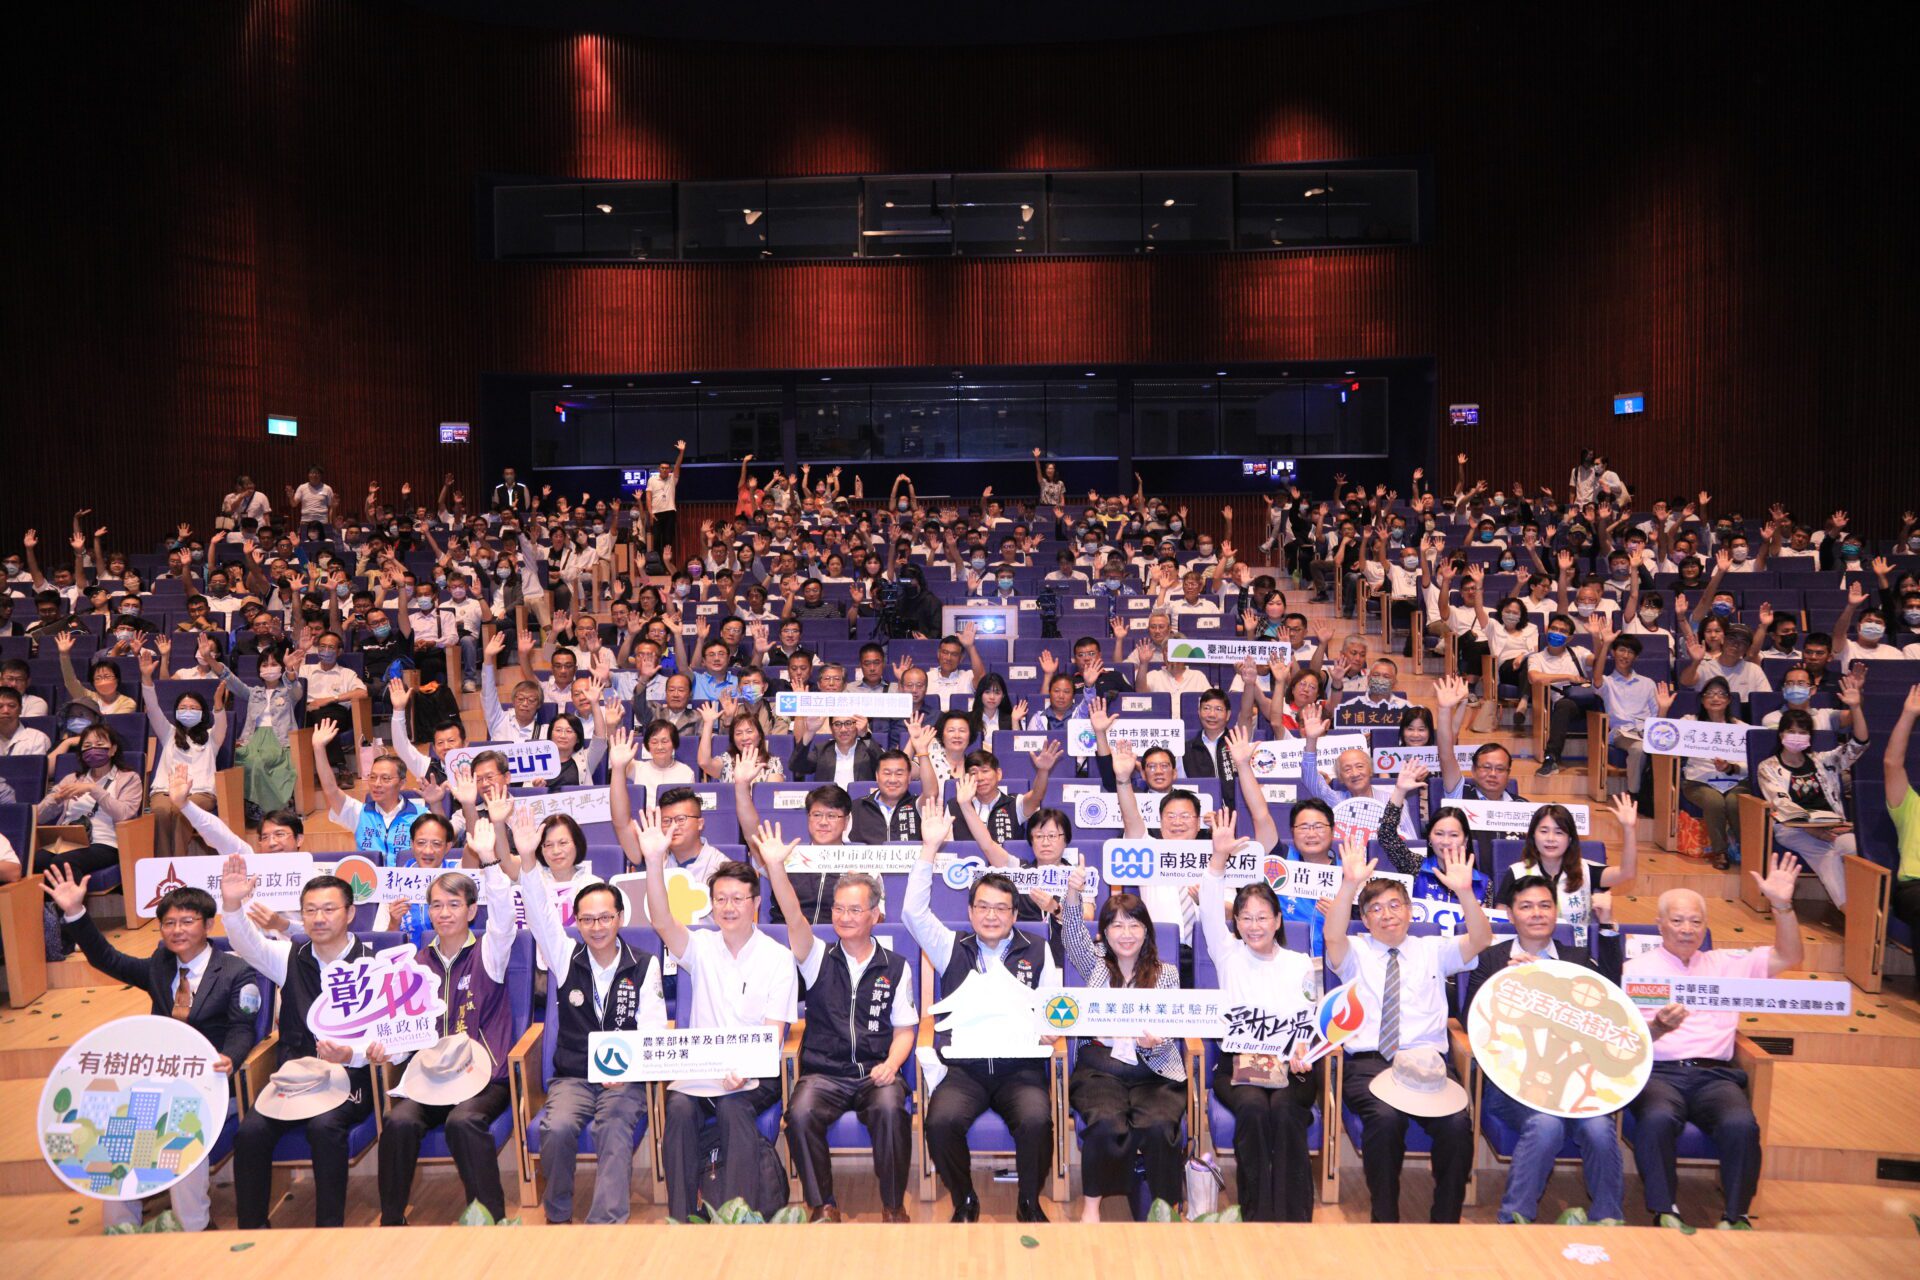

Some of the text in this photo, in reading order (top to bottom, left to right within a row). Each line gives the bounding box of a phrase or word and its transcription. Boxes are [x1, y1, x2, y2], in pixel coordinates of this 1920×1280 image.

[1109, 728, 1180, 738] 台中市景觀工程
[1109, 739, 1170, 748] 商同業公會
[1487, 810, 1586, 824] 臺中市政府局
[207, 872, 301, 890] 新市政府
[972, 870, 1039, 885] 臺市政府
[1294, 867, 1335, 887] 苗栗
[328, 964, 427, 1019] 彰化
[1675, 984, 1720, 994] 中華民國
[1088, 1002, 1218, 1016] 農業部林業試驗所
[1675, 995, 1846, 1011] 景觀工程商業同業公會全國聯合會
[376, 1016, 430, 1037] 縣政府
[643, 1032, 774, 1047] 農業部林業及自然保育署
[643, 1049, 690, 1060] 臺中分署
[1260, 1043, 1282, 1052] Time
[78, 1051, 207, 1078] 有樹的城市
